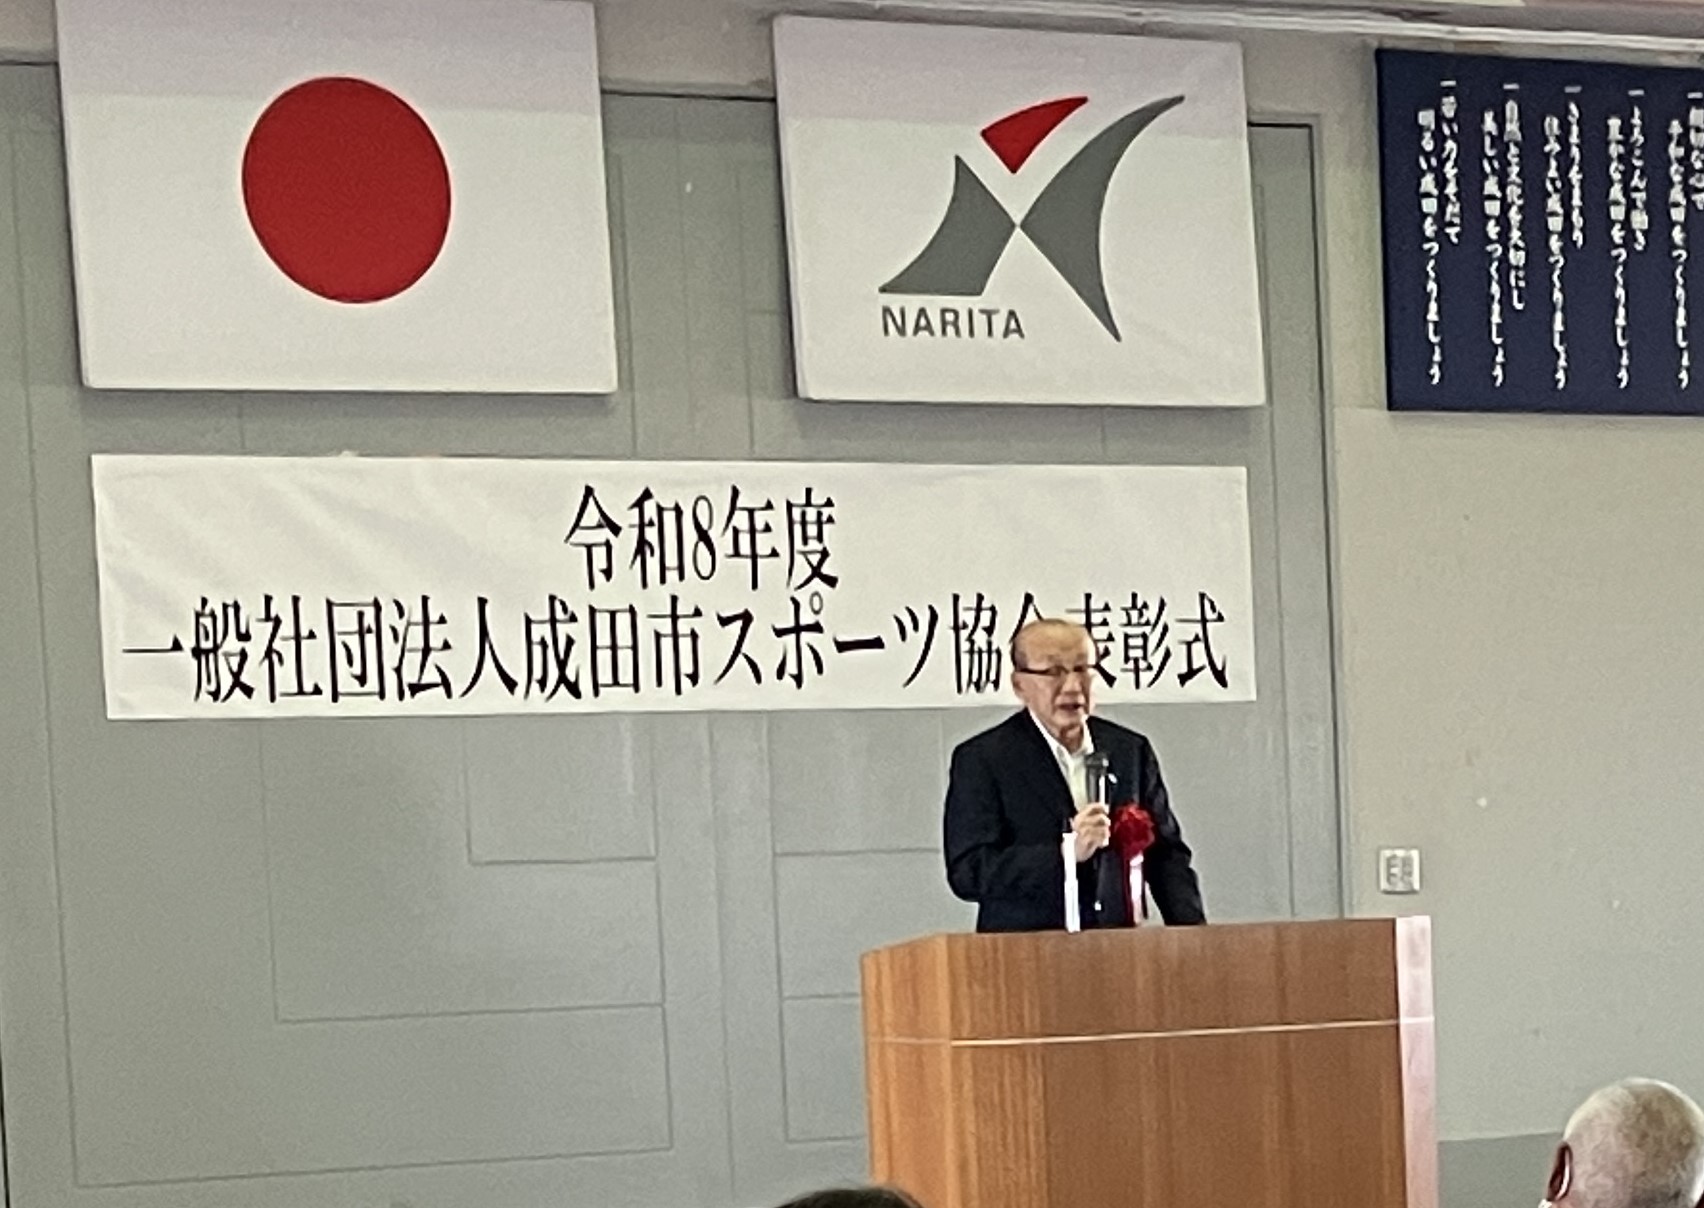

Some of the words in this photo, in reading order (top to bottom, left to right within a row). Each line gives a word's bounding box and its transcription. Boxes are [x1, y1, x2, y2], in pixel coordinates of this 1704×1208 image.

[881, 305, 1026, 340] NARITA
[563, 483, 840, 591] 令和8年度
